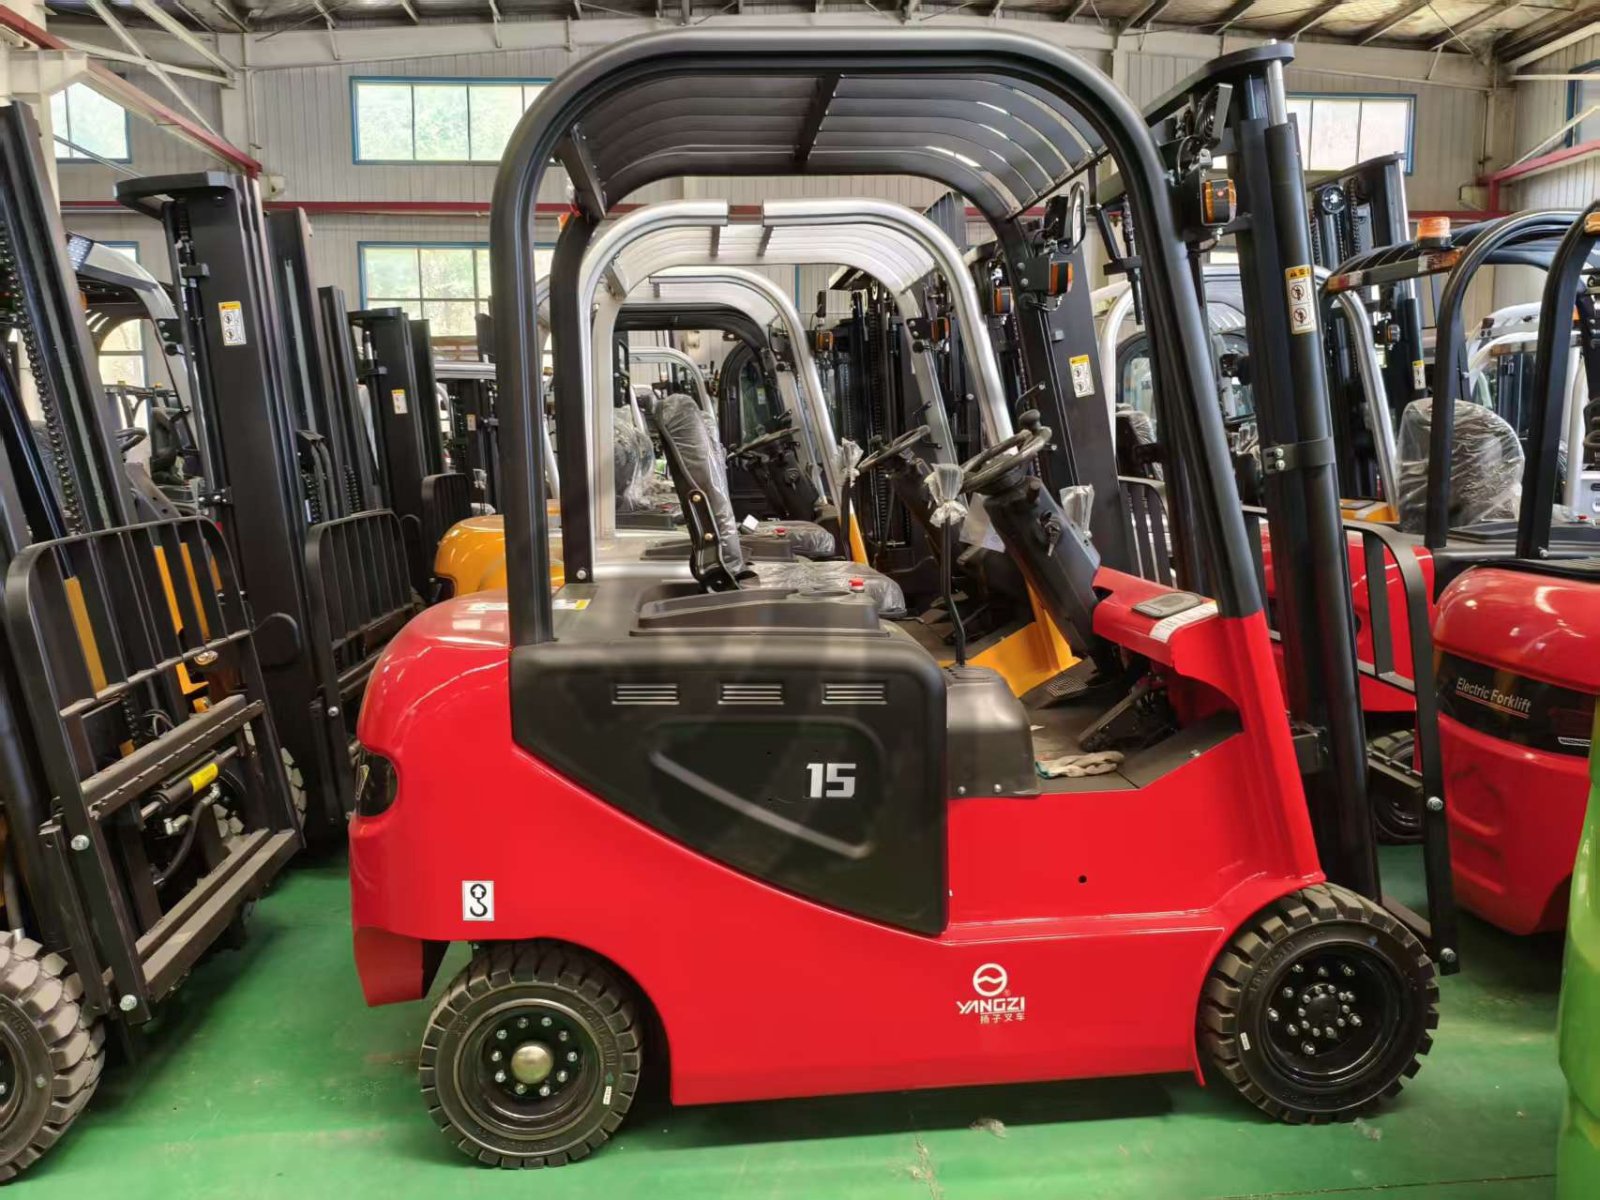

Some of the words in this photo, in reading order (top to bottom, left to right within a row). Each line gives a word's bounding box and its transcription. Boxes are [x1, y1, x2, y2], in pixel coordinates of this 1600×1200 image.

[1456, 678, 1489, 699] Electric
[1490, 689, 1532, 713] Forklift
[806, 763, 857, 798] 15
[956, 996, 1025, 1015] YANGZI
[980, 1013, 1026, 1025] 扬子叉车
